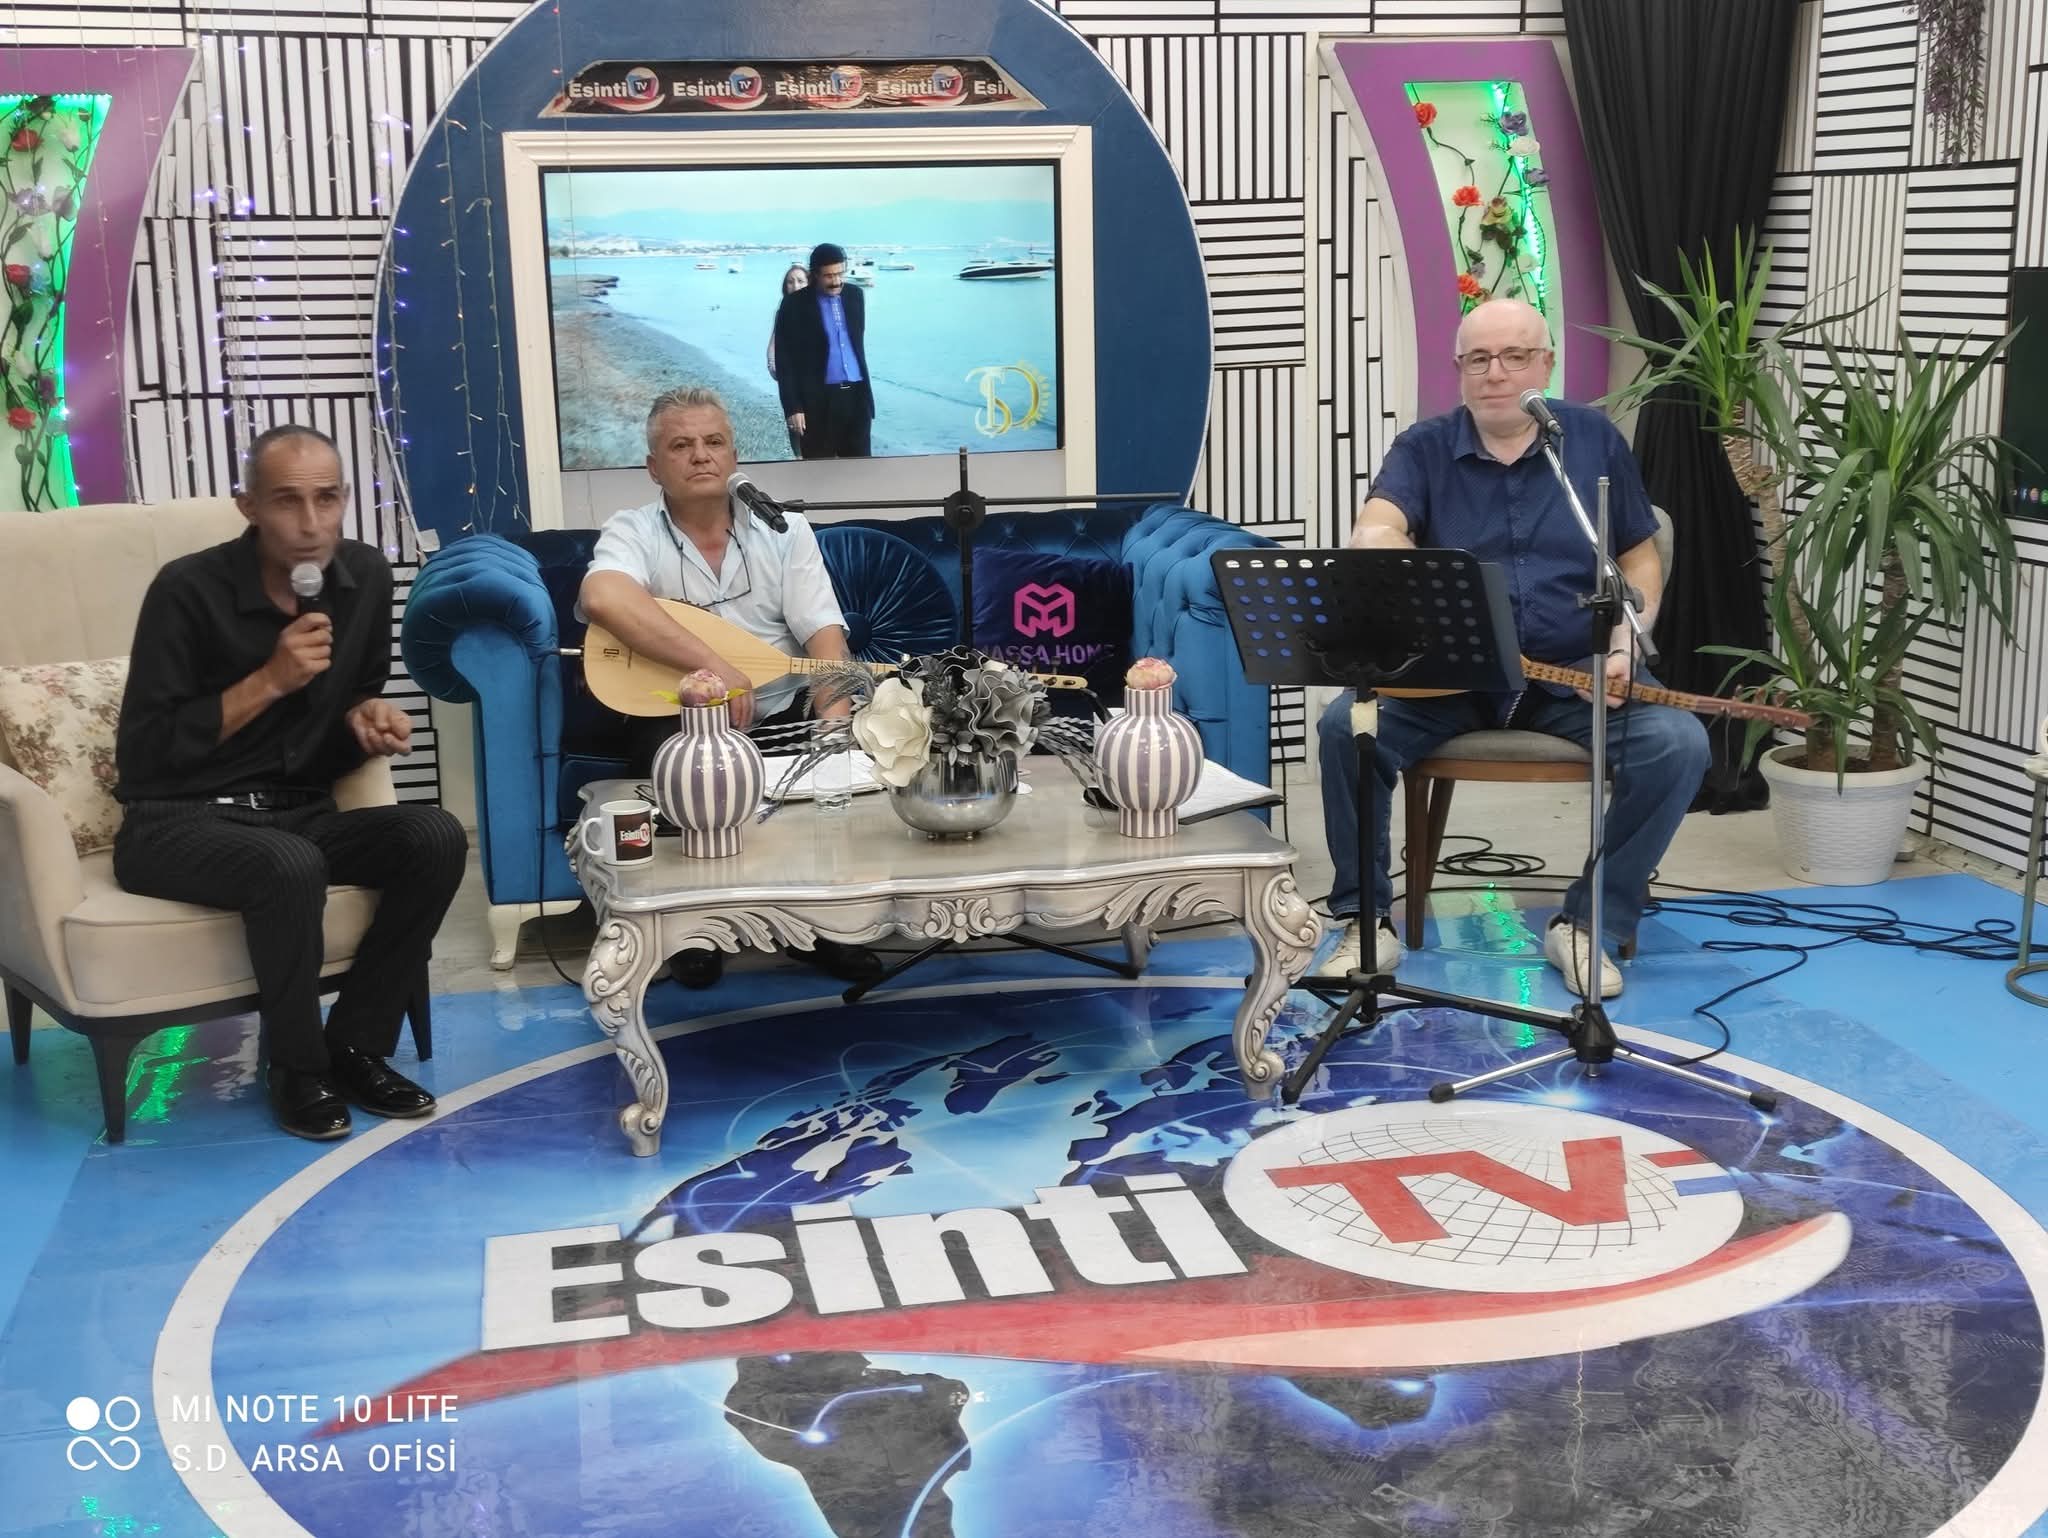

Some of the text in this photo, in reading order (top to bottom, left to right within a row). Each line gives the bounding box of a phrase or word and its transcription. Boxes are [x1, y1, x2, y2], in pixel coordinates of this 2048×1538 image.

[569, 80, 649, 98] Esinti TV
[672, 79, 752, 97] Esinti TV
[877, 79, 934, 96] Esinti
[481, 1136, 1632, 1351] Esinti TV
